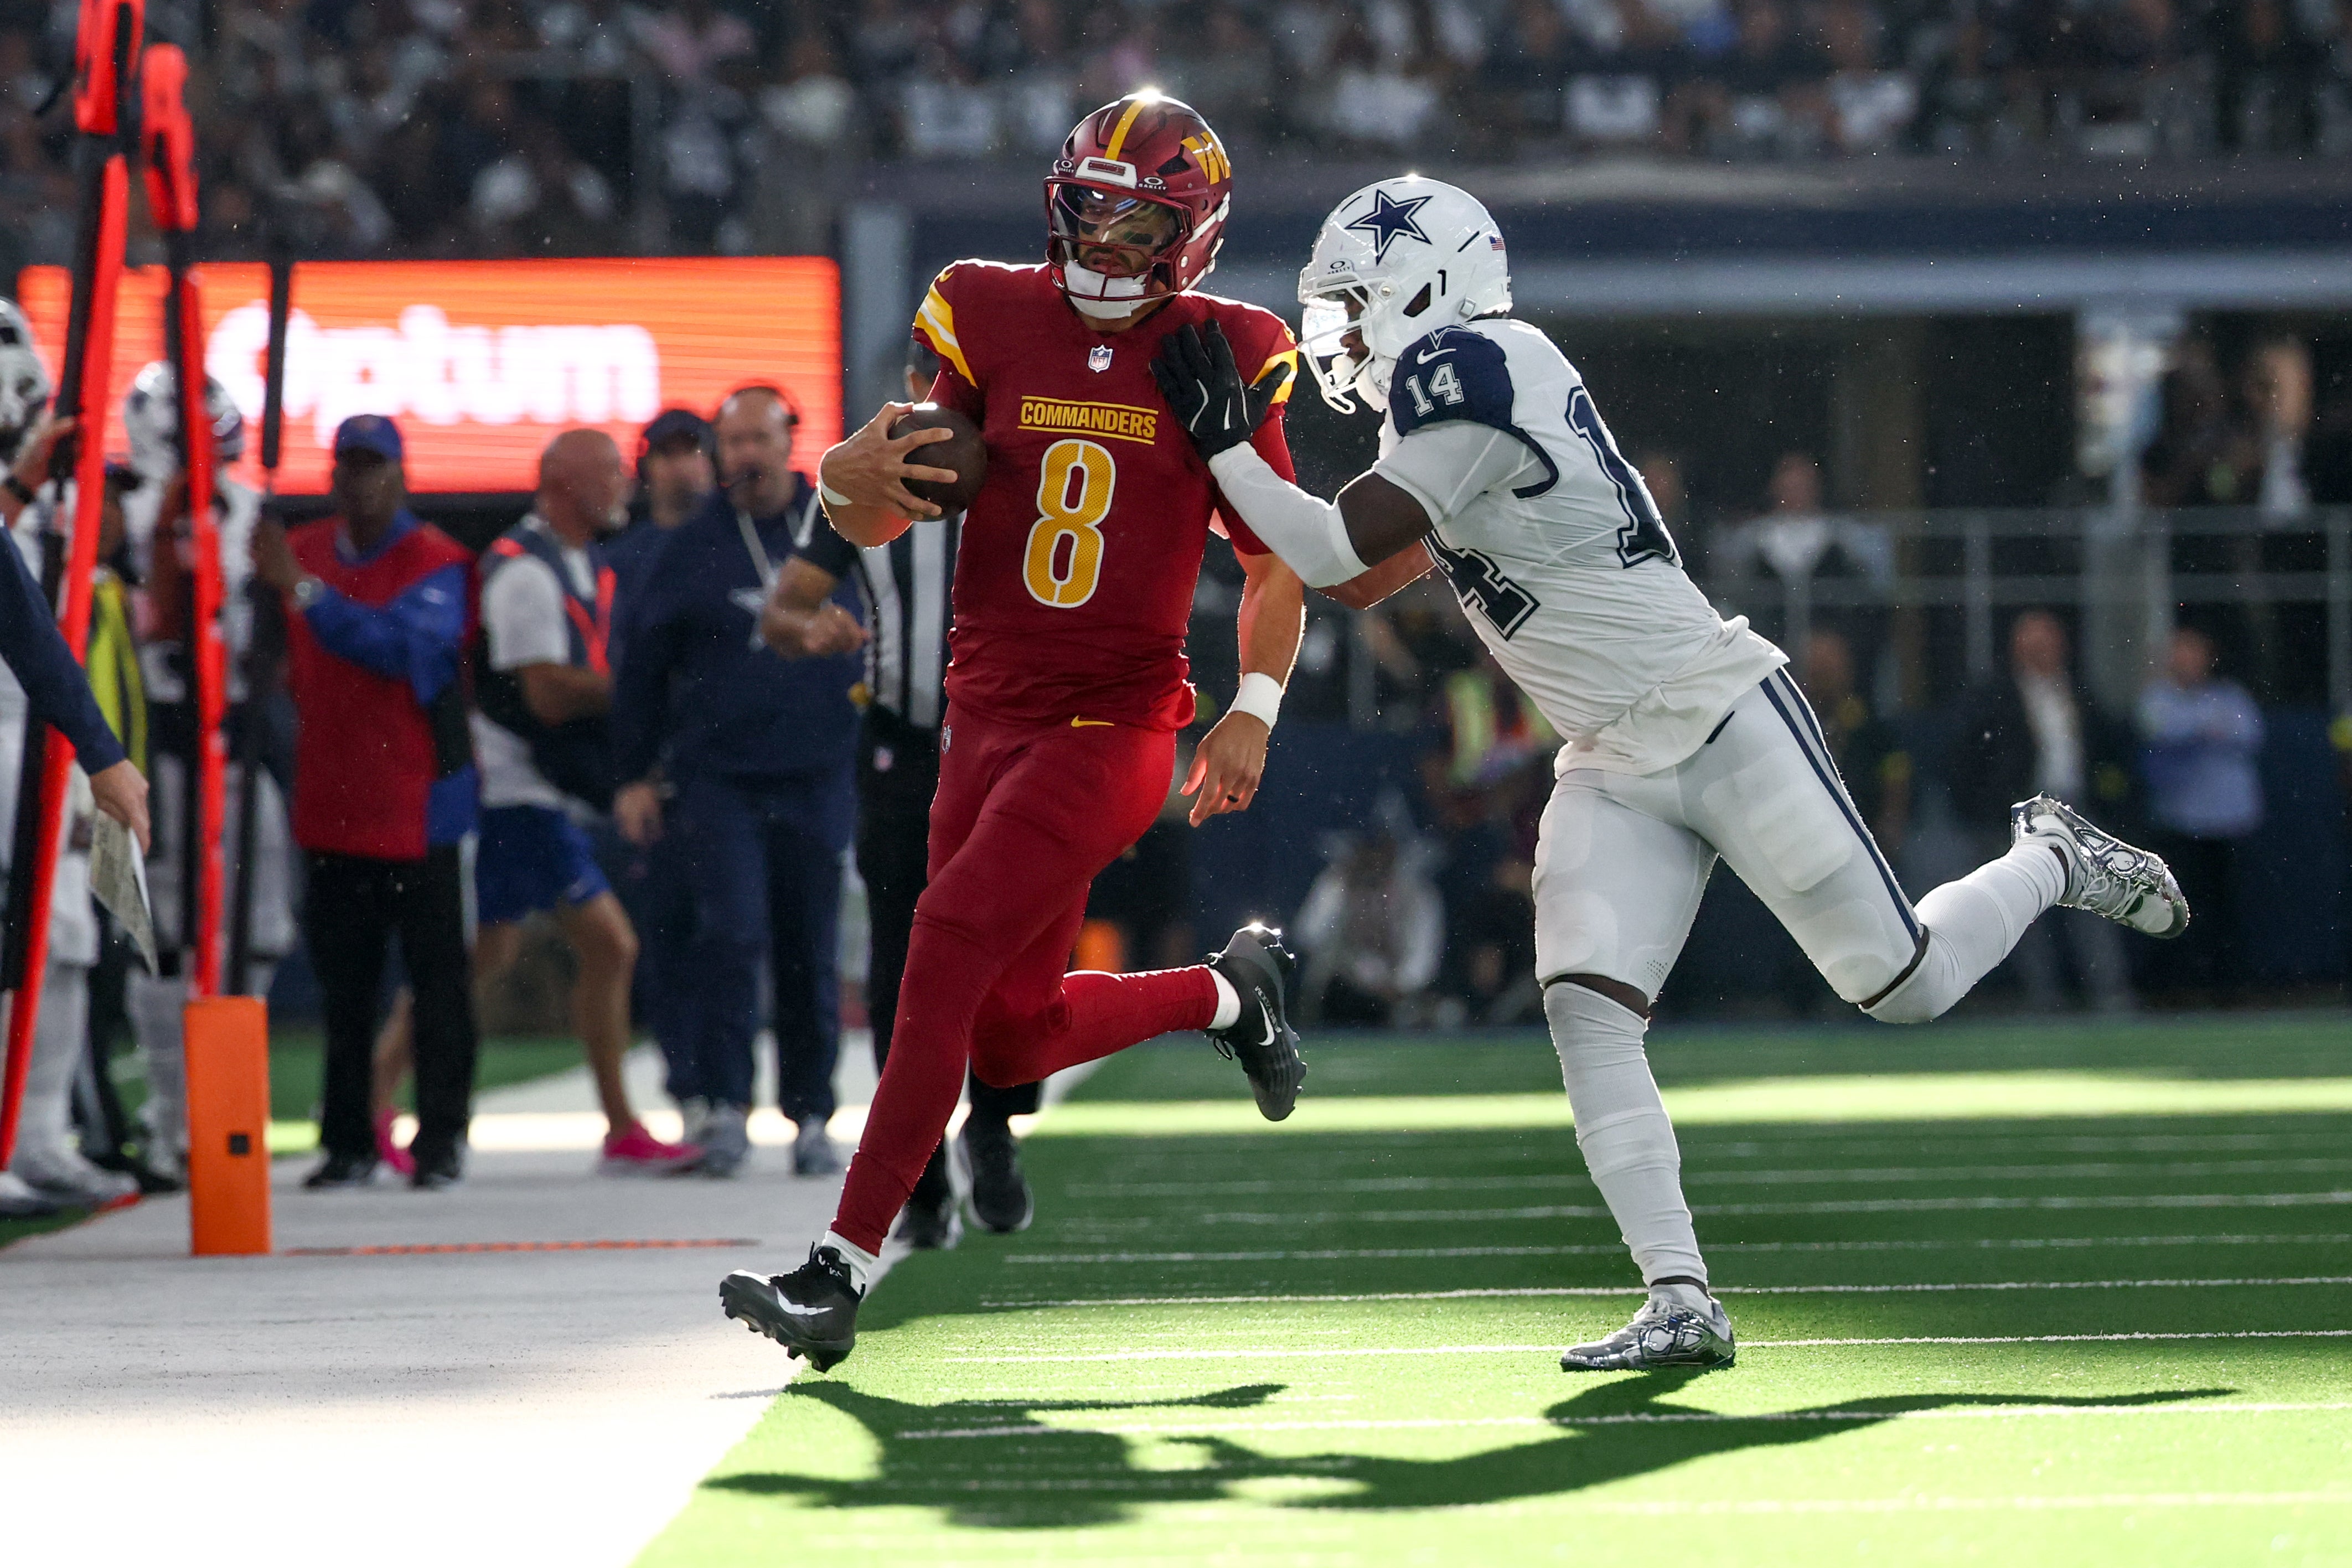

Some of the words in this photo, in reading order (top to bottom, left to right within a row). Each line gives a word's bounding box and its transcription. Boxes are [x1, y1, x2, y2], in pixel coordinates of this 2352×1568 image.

[1405, 363, 1465, 417] 14
[1021, 402, 1156, 438] COMMANDERS
[1022, 438, 1116, 609] 8
